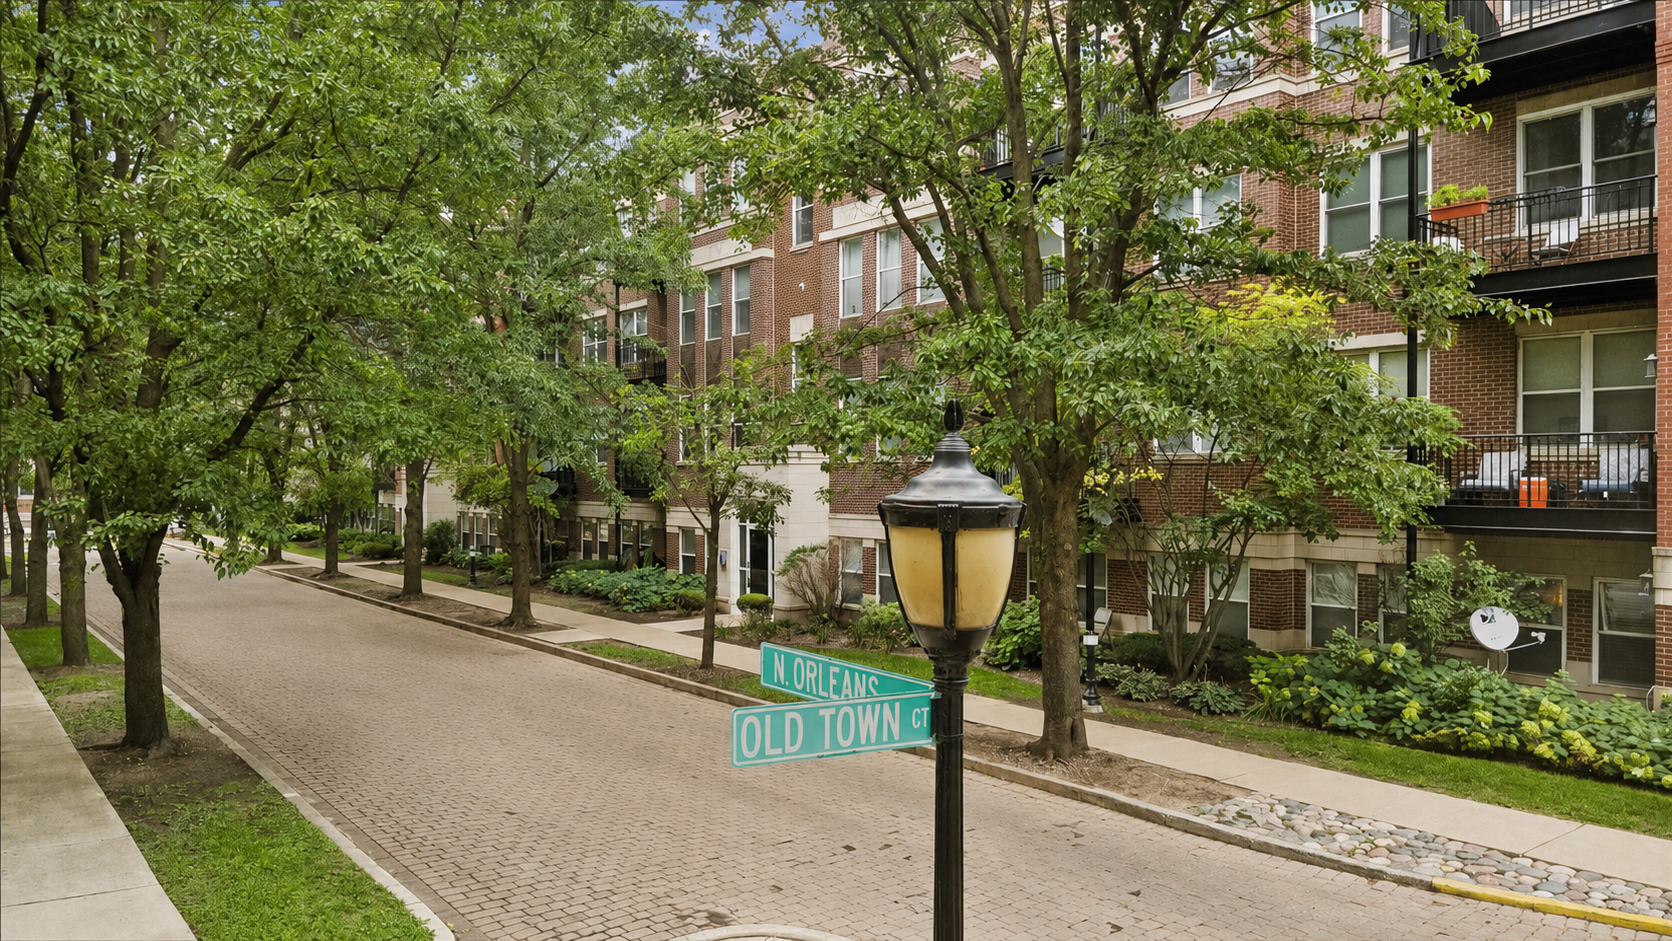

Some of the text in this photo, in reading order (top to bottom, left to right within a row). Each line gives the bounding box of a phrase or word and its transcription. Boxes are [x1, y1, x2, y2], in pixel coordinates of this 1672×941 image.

[774, 652, 879, 700] N. ORLEANS
[741, 702, 930, 758] OLD TOWN CT
